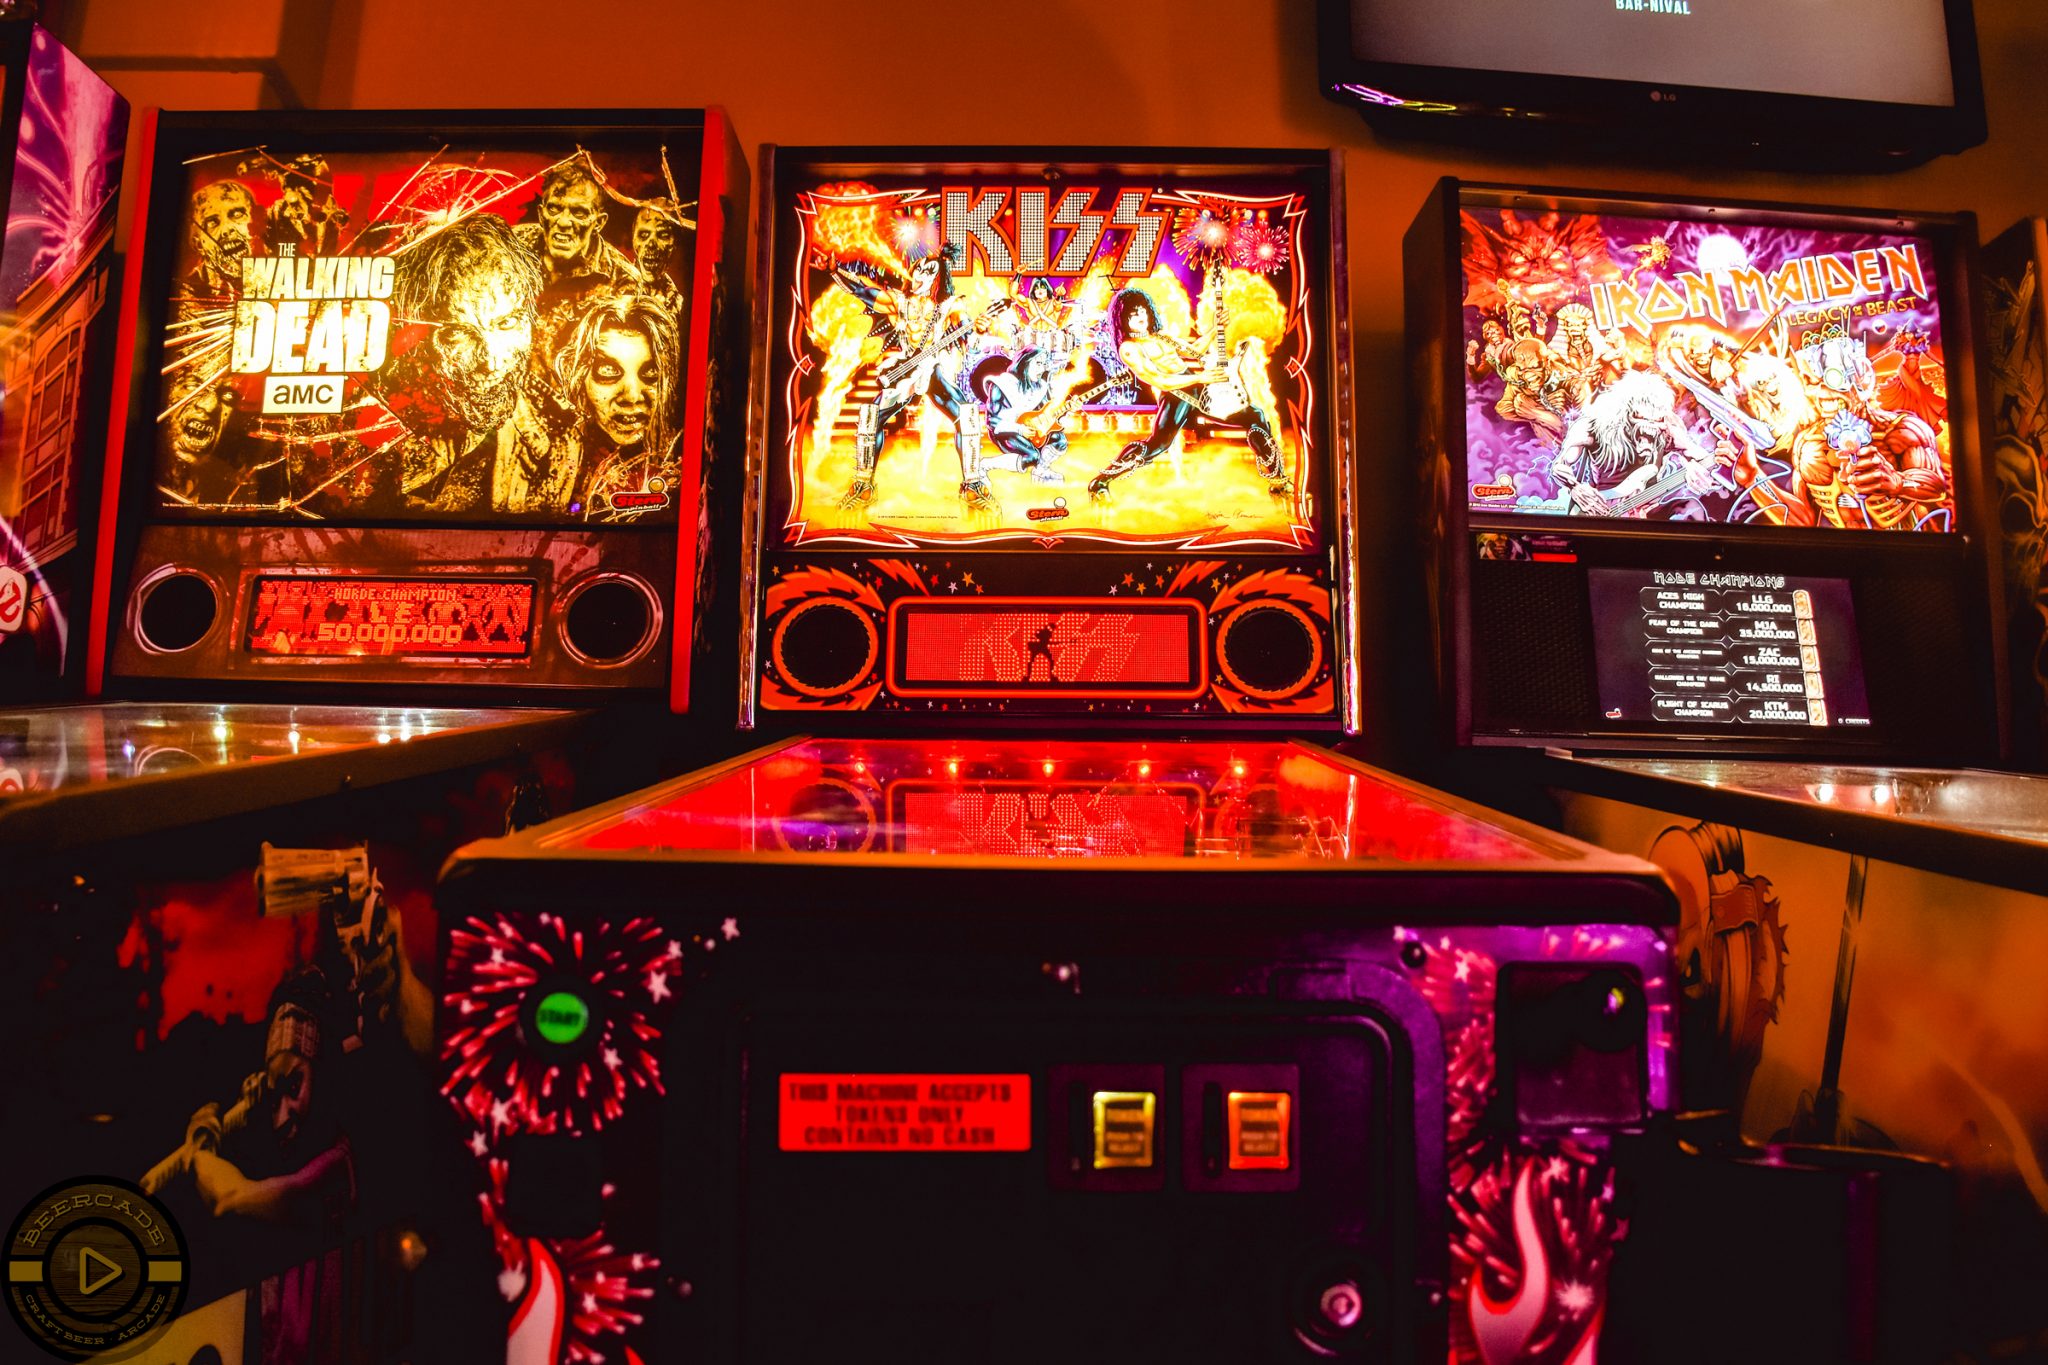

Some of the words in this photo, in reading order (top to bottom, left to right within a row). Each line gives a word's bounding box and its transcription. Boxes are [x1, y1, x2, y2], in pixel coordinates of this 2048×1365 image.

[1615, 0, 1691, 15] BAR-NIVAL
[941, 186, 1171, 278] KISS
[278, 242, 296, 257] THE
[242, 256, 396, 300] WALKING
[1589, 269, 1728, 339] IRON
[1727, 243, 1928, 318] MAIDEN
[1787, 305, 1850, 326] LEGACY
[1865, 297, 1917, 317] BEAST
[231, 300, 390, 373] DEAD
[1476, 487, 1513, 497] Stern
[1029, 510, 1067, 519] Stern
[1653, 571, 1696, 585] MODE
[1700, 574, 1785, 590] CHAMPIONS
[334, 588, 376, 600] HORDE
[382, 589, 457, 601] CHAMPION
[1659, 601, 1704, 609] CHAMPION
[959, 613, 1140, 682] KISS
[1758, 647, 1781, 657] ZAC
[1764, 702, 1788, 711] KTM
[790, 1084, 828, 1101] THIS
[837, 1084, 917, 1101] MACHINE
[929, 1084, 1011, 1101] ACCEPTS
[836, 1106, 907, 1123] TOKENS
[918, 1106, 964, 1123] ONLY
[804, 1127, 899, 1145] CONTAINS
[908, 1128, 934, 1145] NO
[944, 1128, 995, 1145] CASH
